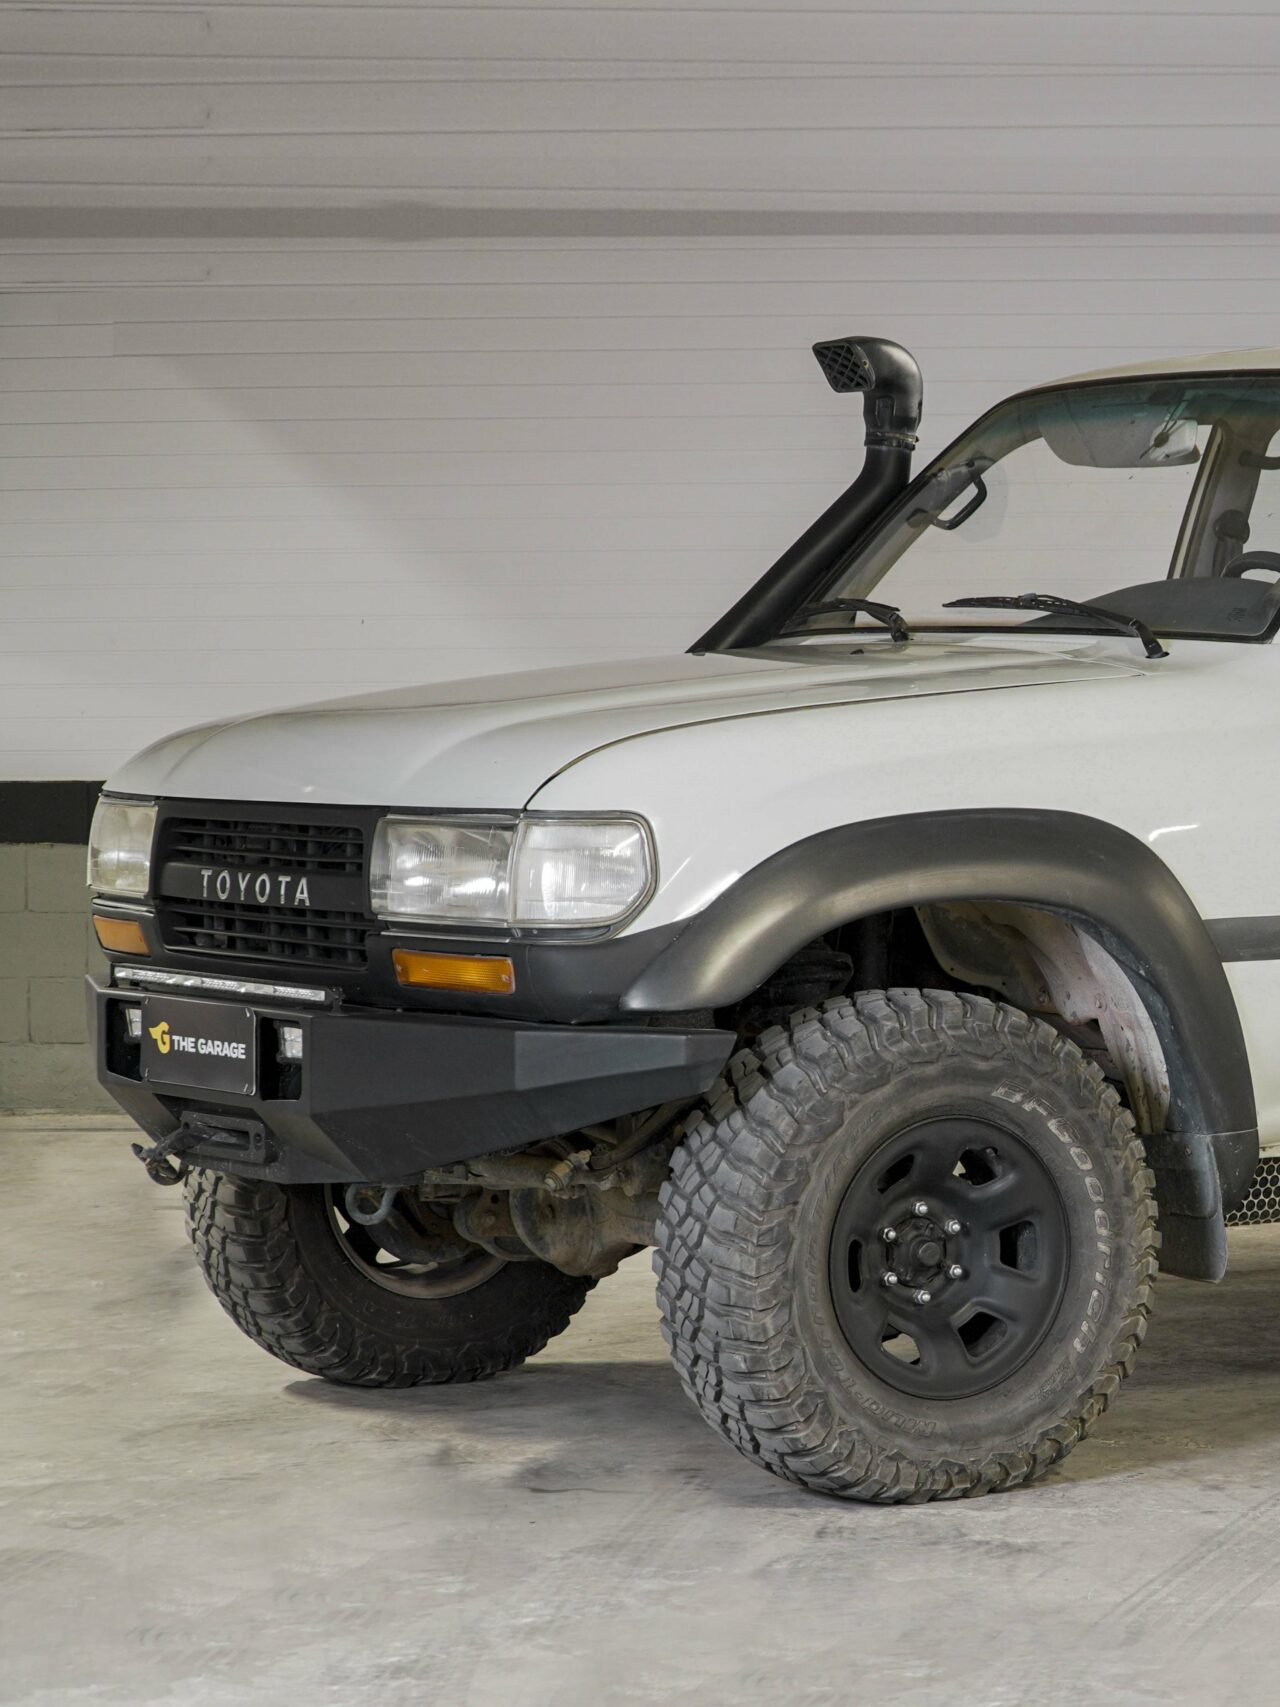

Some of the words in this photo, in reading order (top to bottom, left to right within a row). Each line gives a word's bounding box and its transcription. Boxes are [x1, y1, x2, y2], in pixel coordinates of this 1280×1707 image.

[201, 868, 310, 906] TOYOTA
[172, 1035, 196, 1053] THE
[197, 1038, 246, 1059] GARAGE
